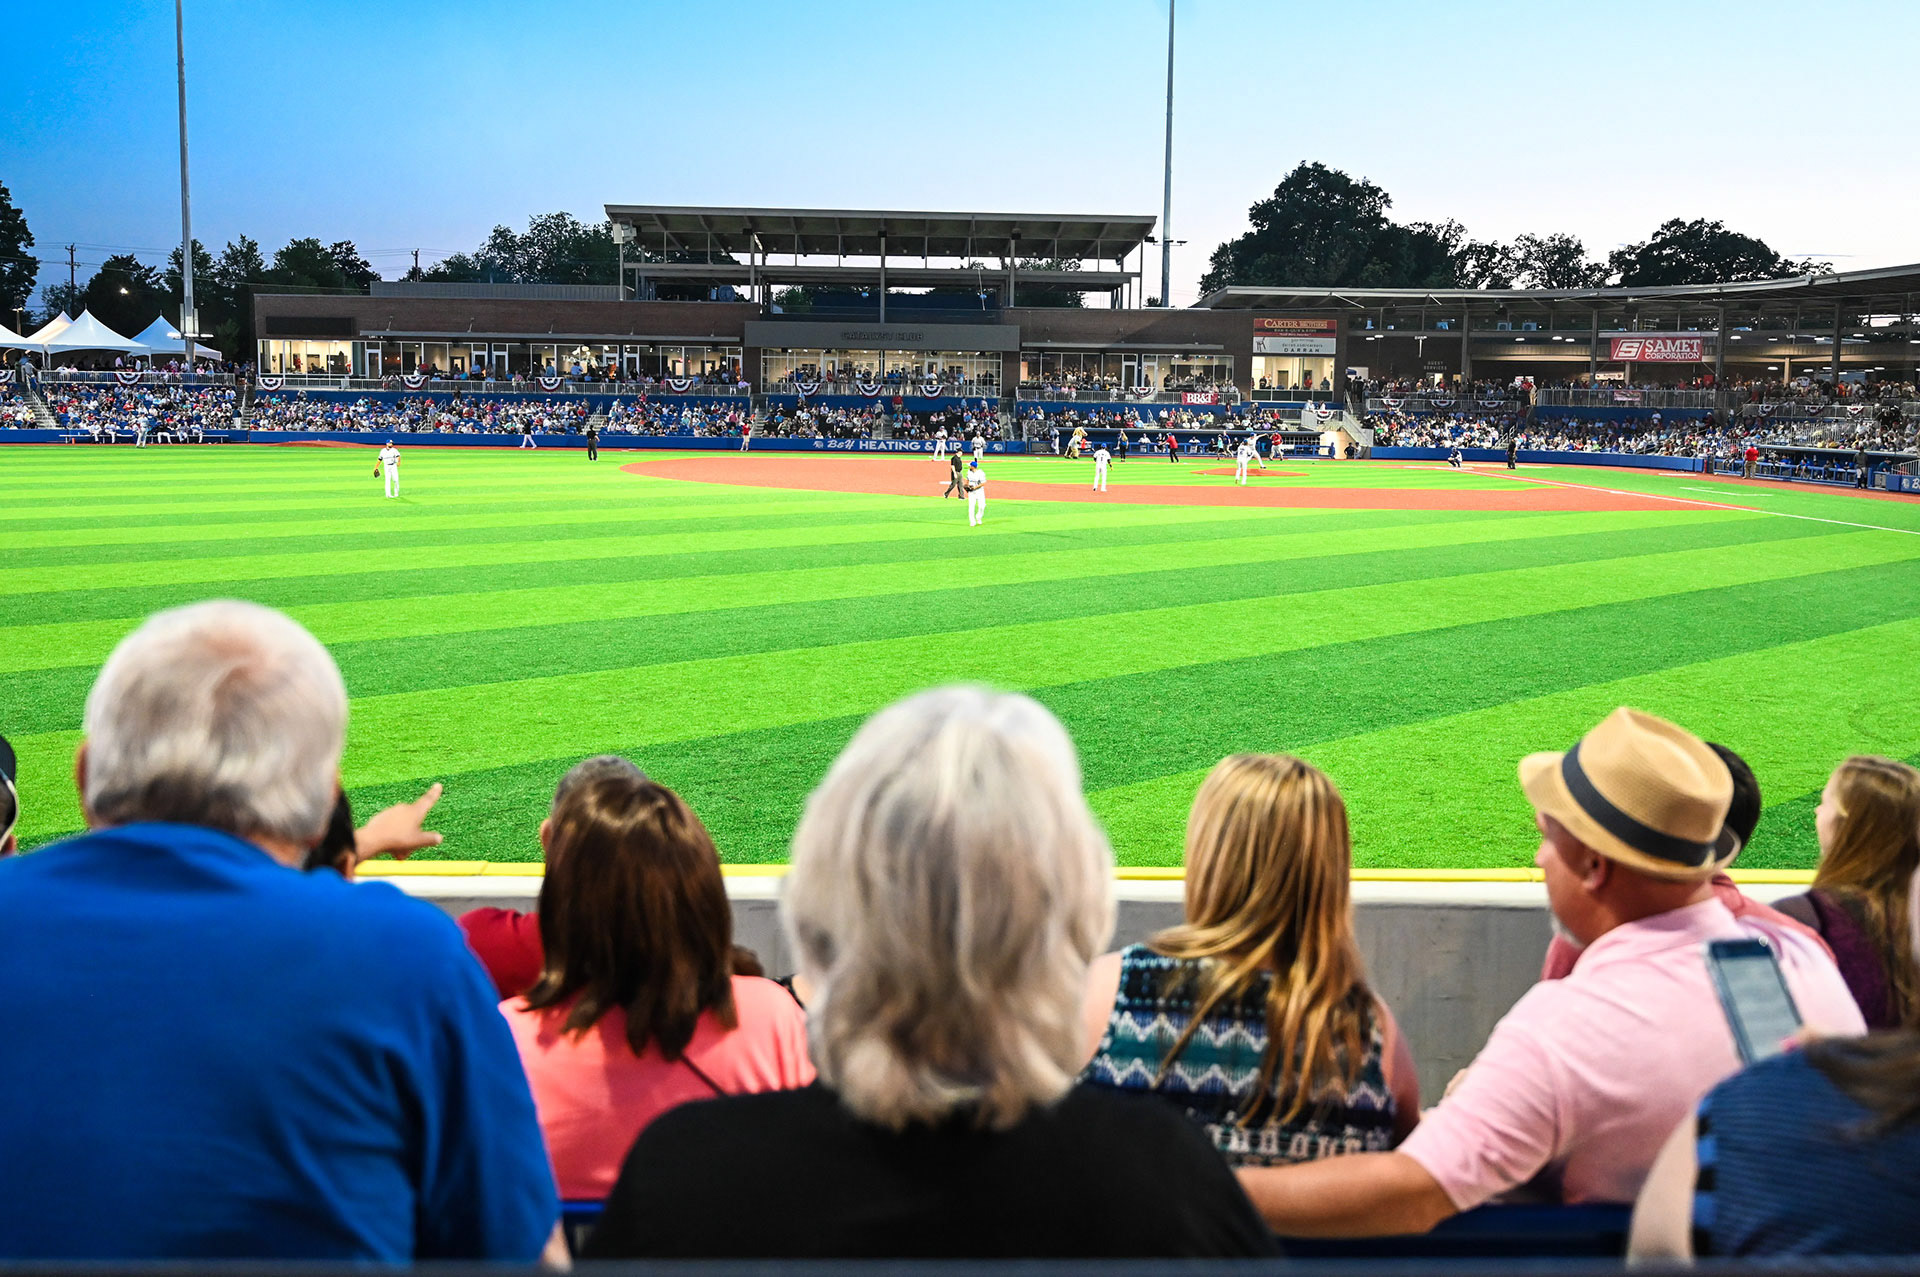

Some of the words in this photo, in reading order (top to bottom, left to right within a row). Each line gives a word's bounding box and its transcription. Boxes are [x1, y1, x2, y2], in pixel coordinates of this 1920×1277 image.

[1264, 319, 1298, 329] CARTER
[1645, 339, 1700, 353] SAMET
[1644, 352, 1700, 360] CORPORATION
[1187, 392, 1214, 404] BB&T
[859, 440, 921, 451] HEATING
[924, 441, 935, 451] &
